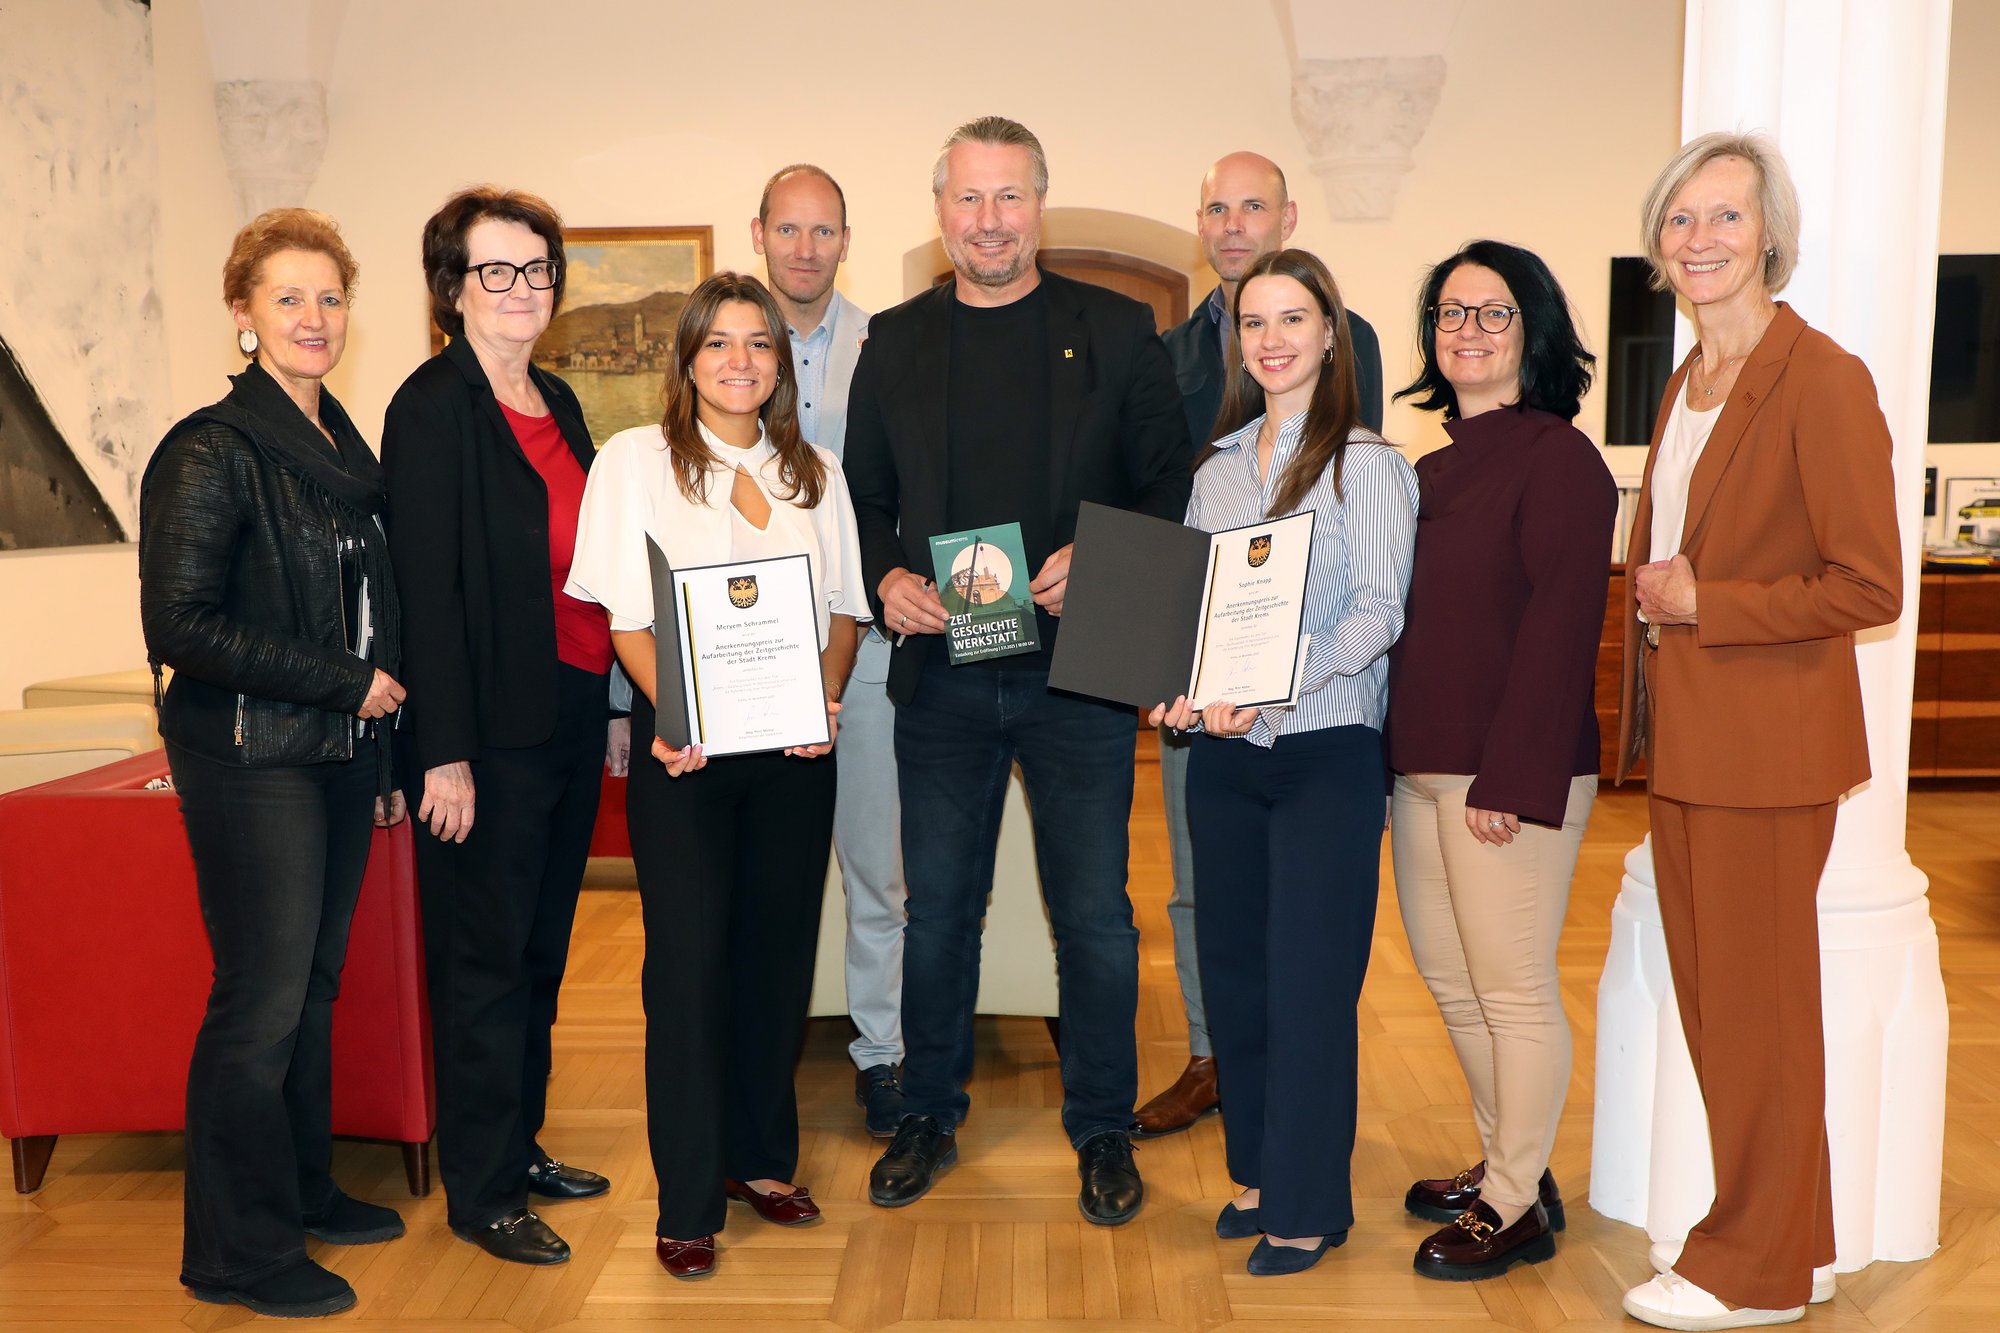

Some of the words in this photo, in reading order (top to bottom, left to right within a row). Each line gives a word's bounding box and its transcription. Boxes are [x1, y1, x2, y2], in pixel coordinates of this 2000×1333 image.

[716, 622, 742, 631] Meryem
[743, 617, 779, 628] Schrammel
[950, 613, 972, 626] ZEIT
[951, 618, 1018, 638] GESCHICHTE
[715, 638, 773, 651] Anerkennungspreis
[953, 630, 1018, 651] WERKSTATT
[701, 650, 743, 661] Aufarbeitung
[743, 648, 755, 656] der
[755, 643, 800, 655] Zeitgeschichte
[726, 657, 738, 665] der
[738, 653, 757, 664] Stadt
[757, 654, 777, 662] Krems
